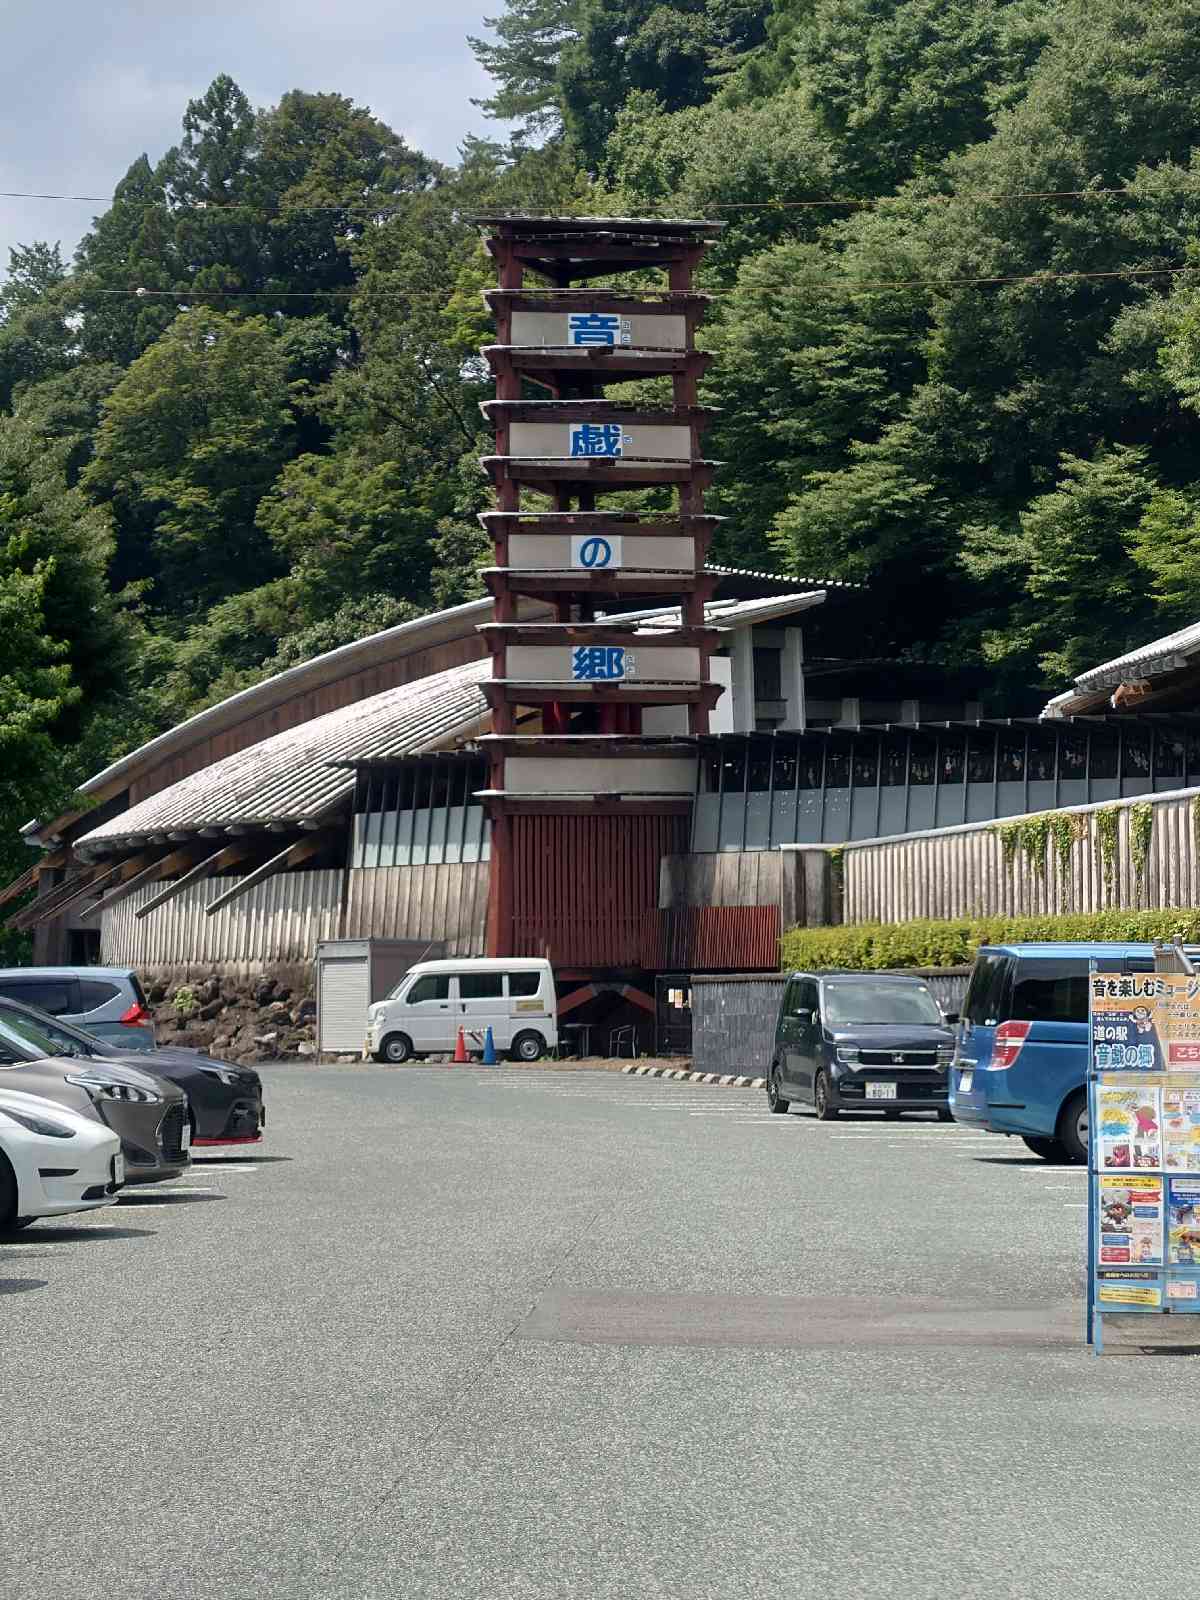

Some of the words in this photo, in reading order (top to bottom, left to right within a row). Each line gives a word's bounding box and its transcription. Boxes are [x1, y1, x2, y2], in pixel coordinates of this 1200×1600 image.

[569, 314, 619, 346] 音
[571, 424, 621, 456] 戯
[580, 537, 611, 567] の
[572, 646, 625, 680] 郷
[1093, 1025, 1128, 1041] 道の駅
[1095, 1043, 1155, 1068] 音戯の郷
